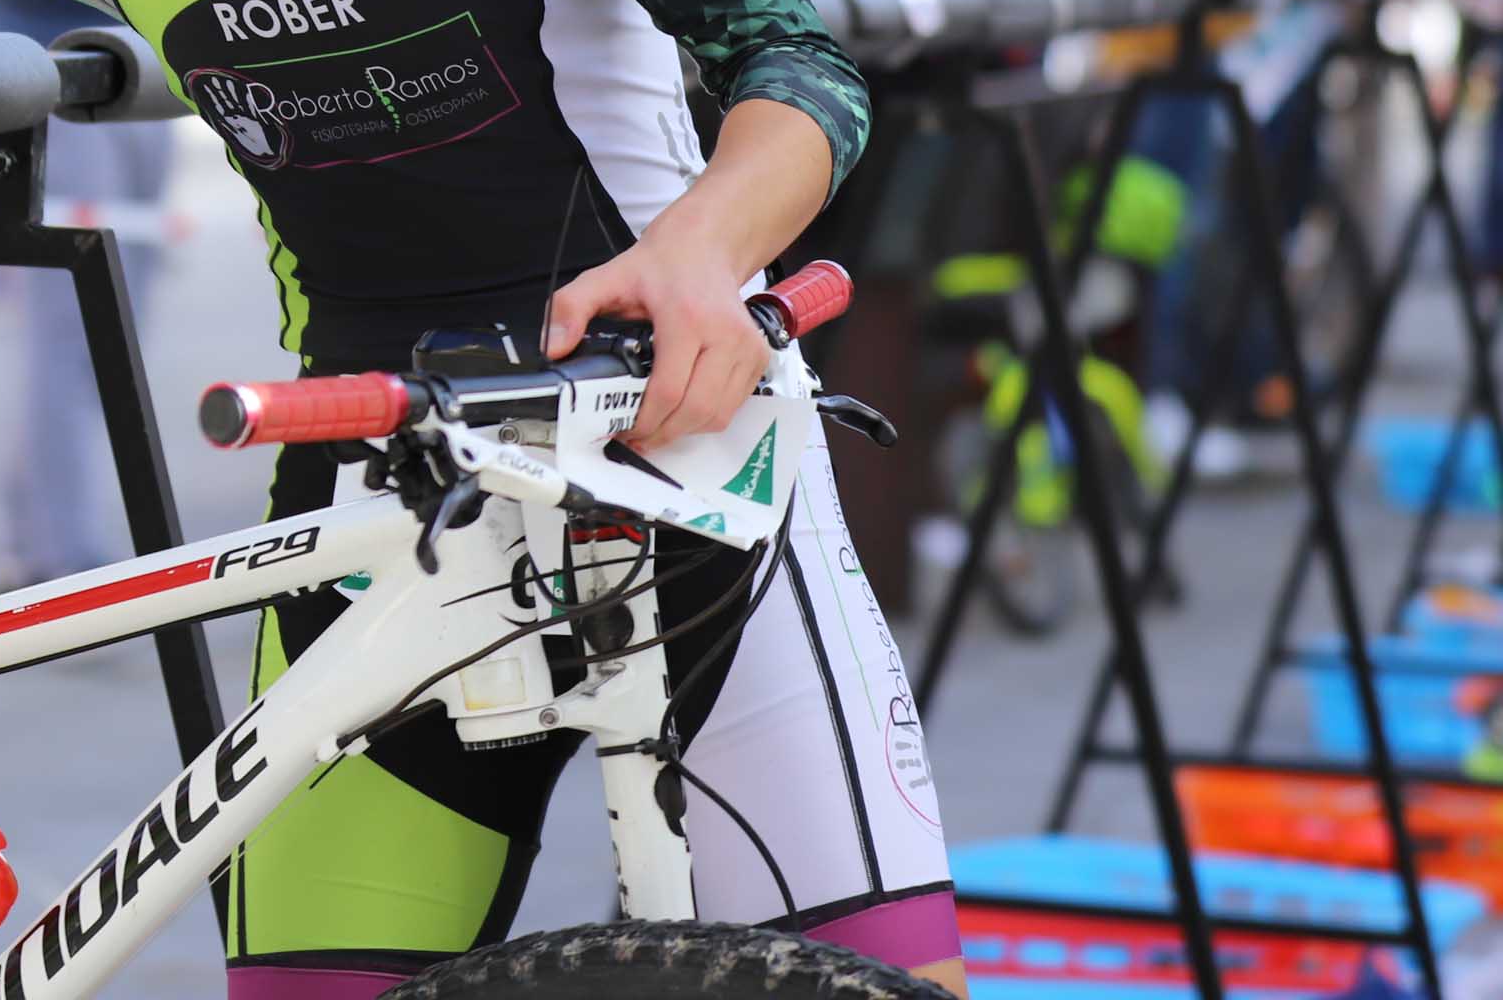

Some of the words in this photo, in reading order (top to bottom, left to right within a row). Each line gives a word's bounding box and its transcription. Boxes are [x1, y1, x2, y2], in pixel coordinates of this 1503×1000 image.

[246, 82, 374, 126] Roberto
[366, 58, 479, 102] Ramos
[214, 526, 321, 579] F29
